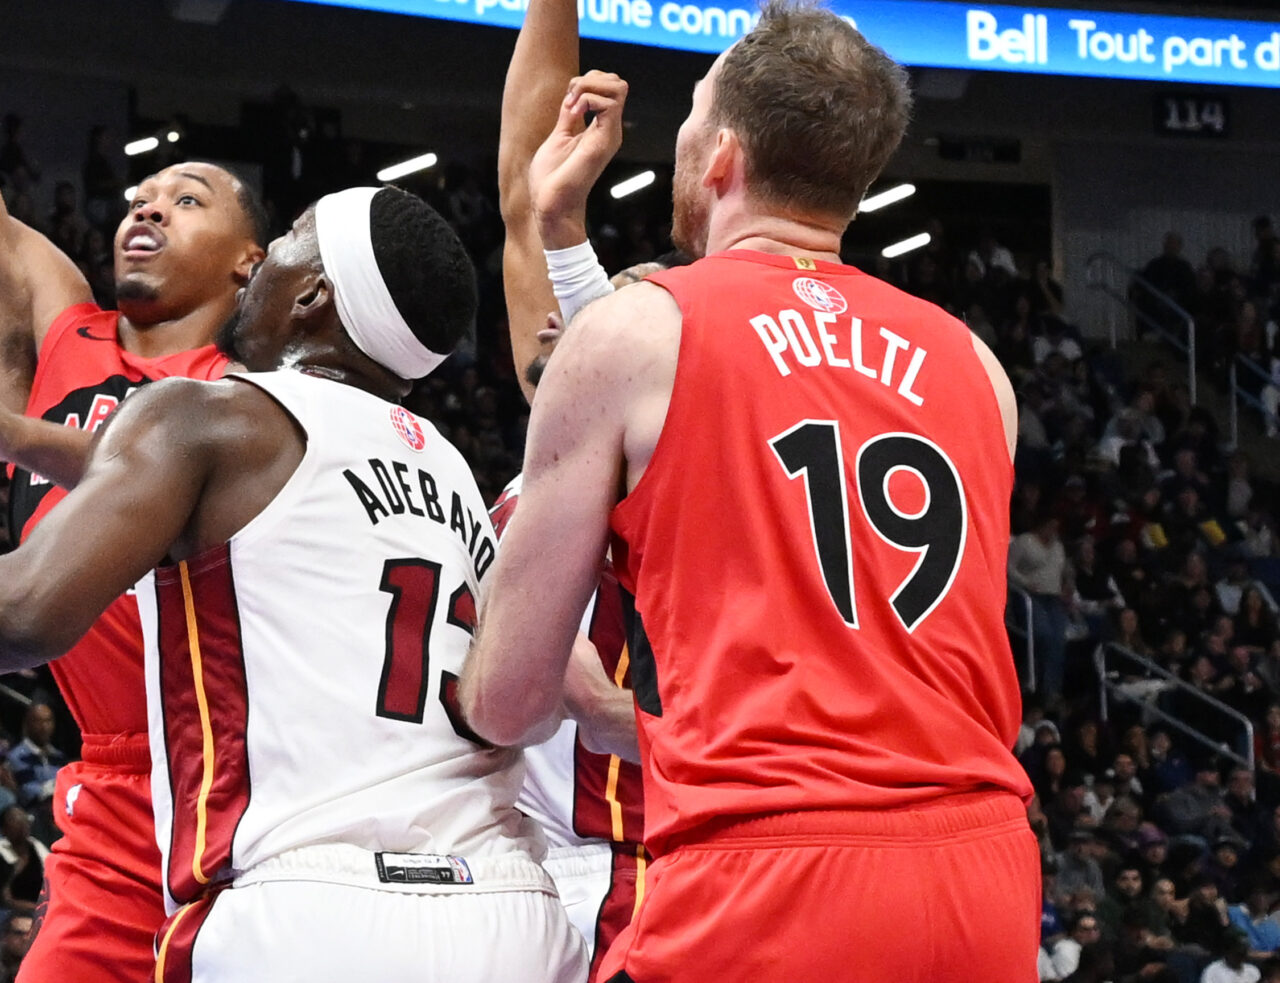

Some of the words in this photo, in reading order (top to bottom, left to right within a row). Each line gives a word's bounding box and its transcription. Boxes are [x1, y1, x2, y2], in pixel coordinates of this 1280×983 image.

[966, 9, 1049, 65] Bell
[1069, 18, 1156, 64] Tout
[1162, 34, 1248, 74] part
[1164, 96, 1225, 134] 114
[749, 307, 928, 406] POELTL
[342, 457, 495, 583] ADEBAYO
[767, 418, 968, 634] 19
